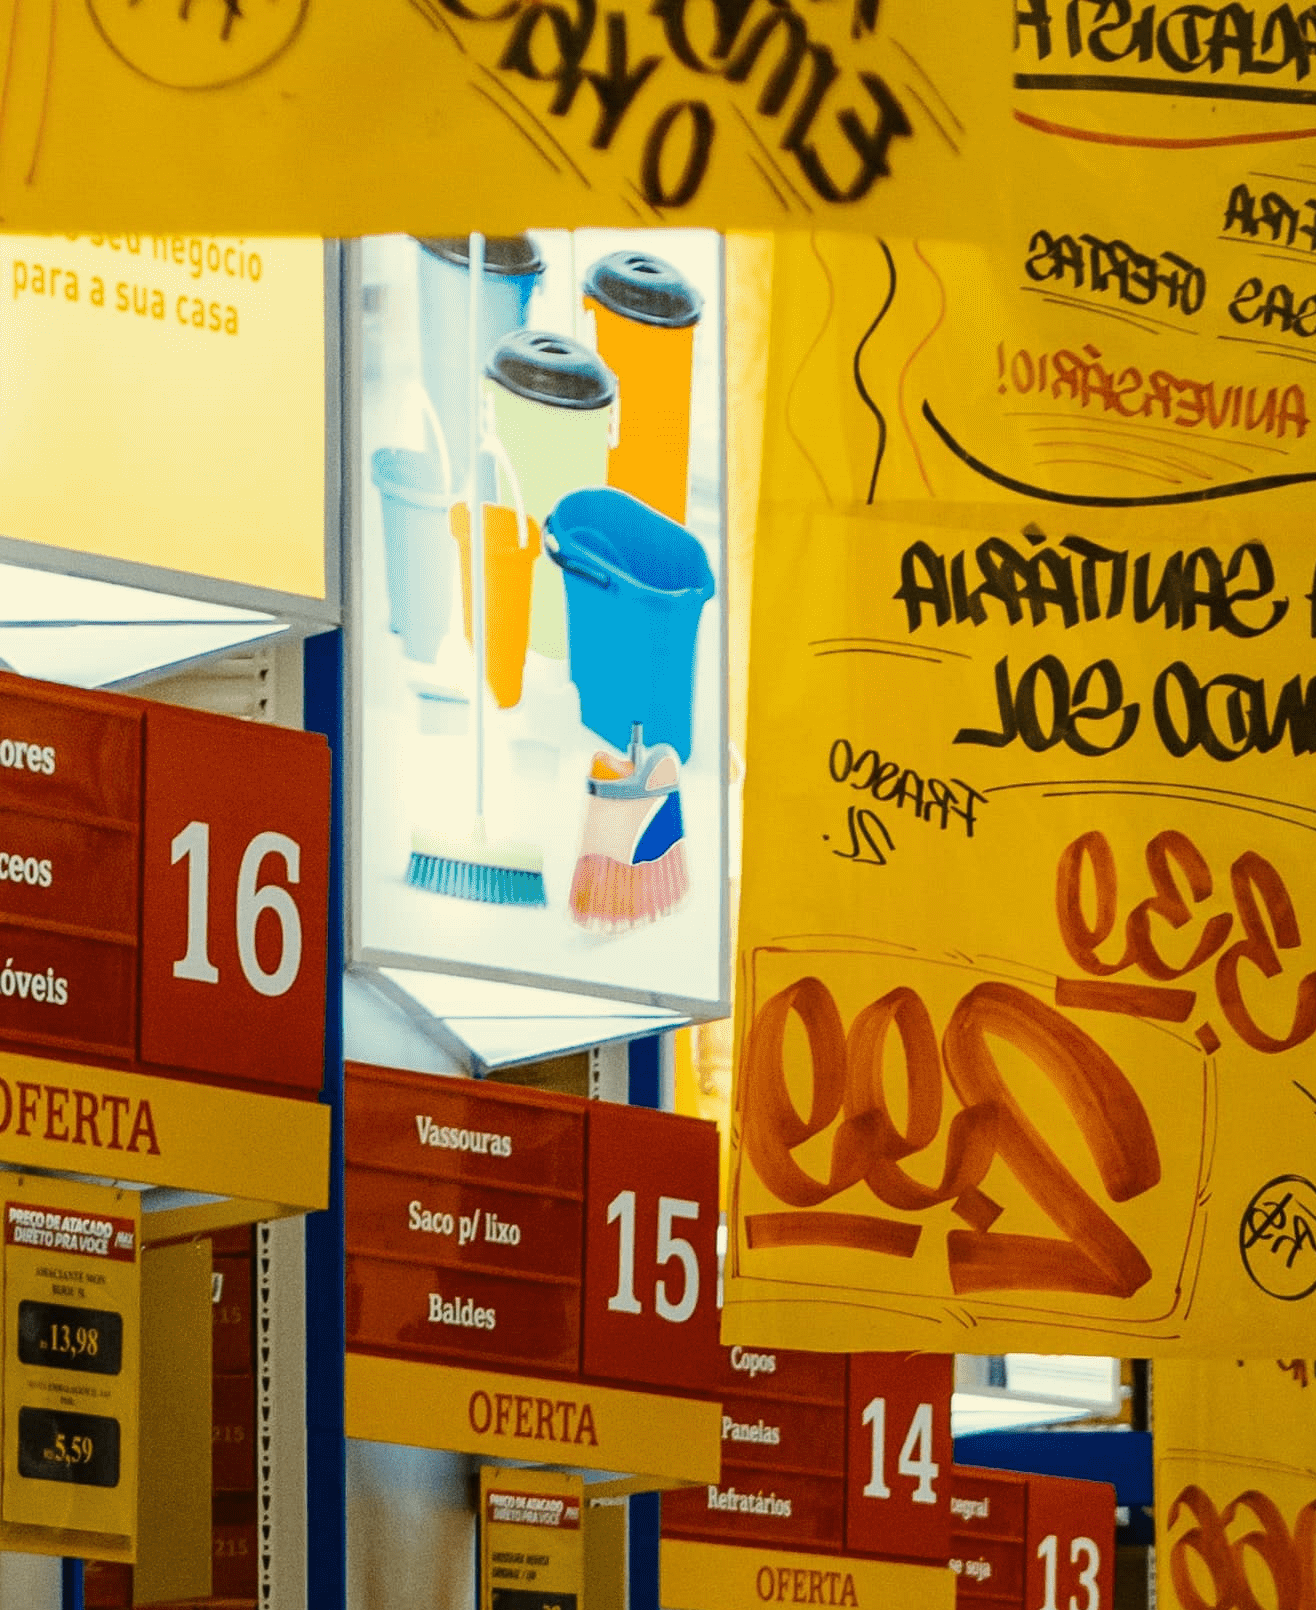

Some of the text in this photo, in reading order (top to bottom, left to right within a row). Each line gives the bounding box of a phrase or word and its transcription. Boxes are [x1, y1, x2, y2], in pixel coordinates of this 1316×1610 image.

[12, 258, 240, 337] para a sua casa
[0, 738, 55, 775] ores
[0, 852, 52, 889] ceos
[170, 820, 302, 997] 16
[0, 957, 68, 1006] óveis
[416, 1115, 512, 1158] Vassouras
[55, 1232, 78, 1250] PRA
[61, 1216, 113, 1239] ATACADO
[408, 1202, 521, 1246] Saco p/ lixo
[606, 1190, 700, 1323] 15
[428, 1293, 496, 1330] Baldes
[51, 1324, 99, 1359] 13,98
[730, 1347, 777, 1376] Copos
[468, 1390, 599, 1447] OFERTA
[721, 1417, 780, 1447] Panelas
[55, 1433, 93, 1468] 5,59
[861, 1397, 940, 1505] 14
[706, 1486, 792, 1518] Refratários
[756, 1565, 860, 1608] OFERTA
